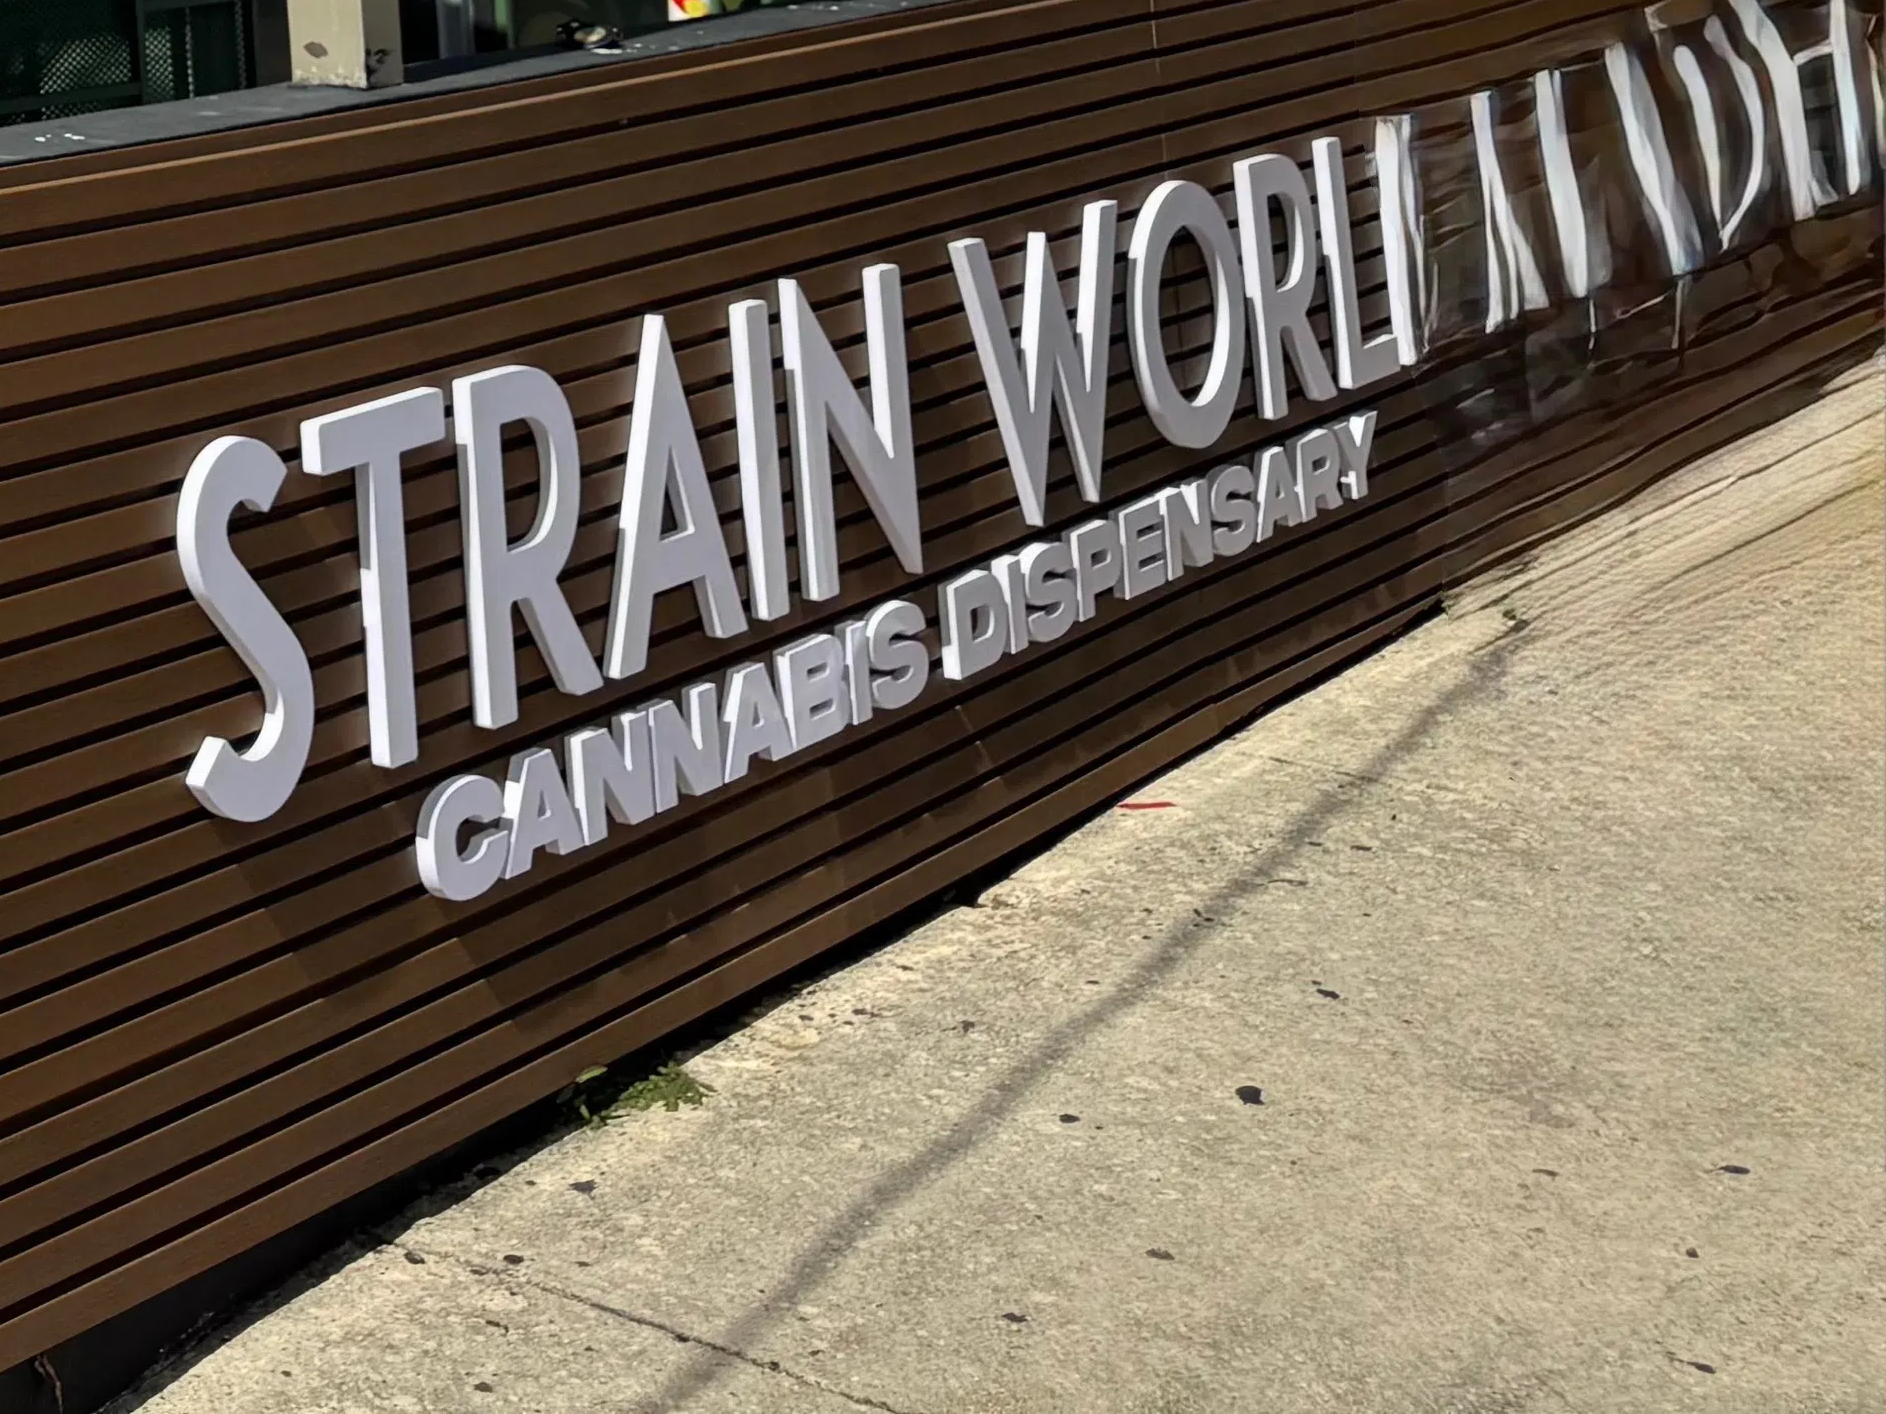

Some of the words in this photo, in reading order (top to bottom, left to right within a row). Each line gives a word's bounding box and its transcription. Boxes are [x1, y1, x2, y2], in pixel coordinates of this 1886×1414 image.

[177, 263, 922, 822] STRAIN
[416, 598, 928, 901] CANNABIS
[941, 410, 1378, 679] DISPENSARY
